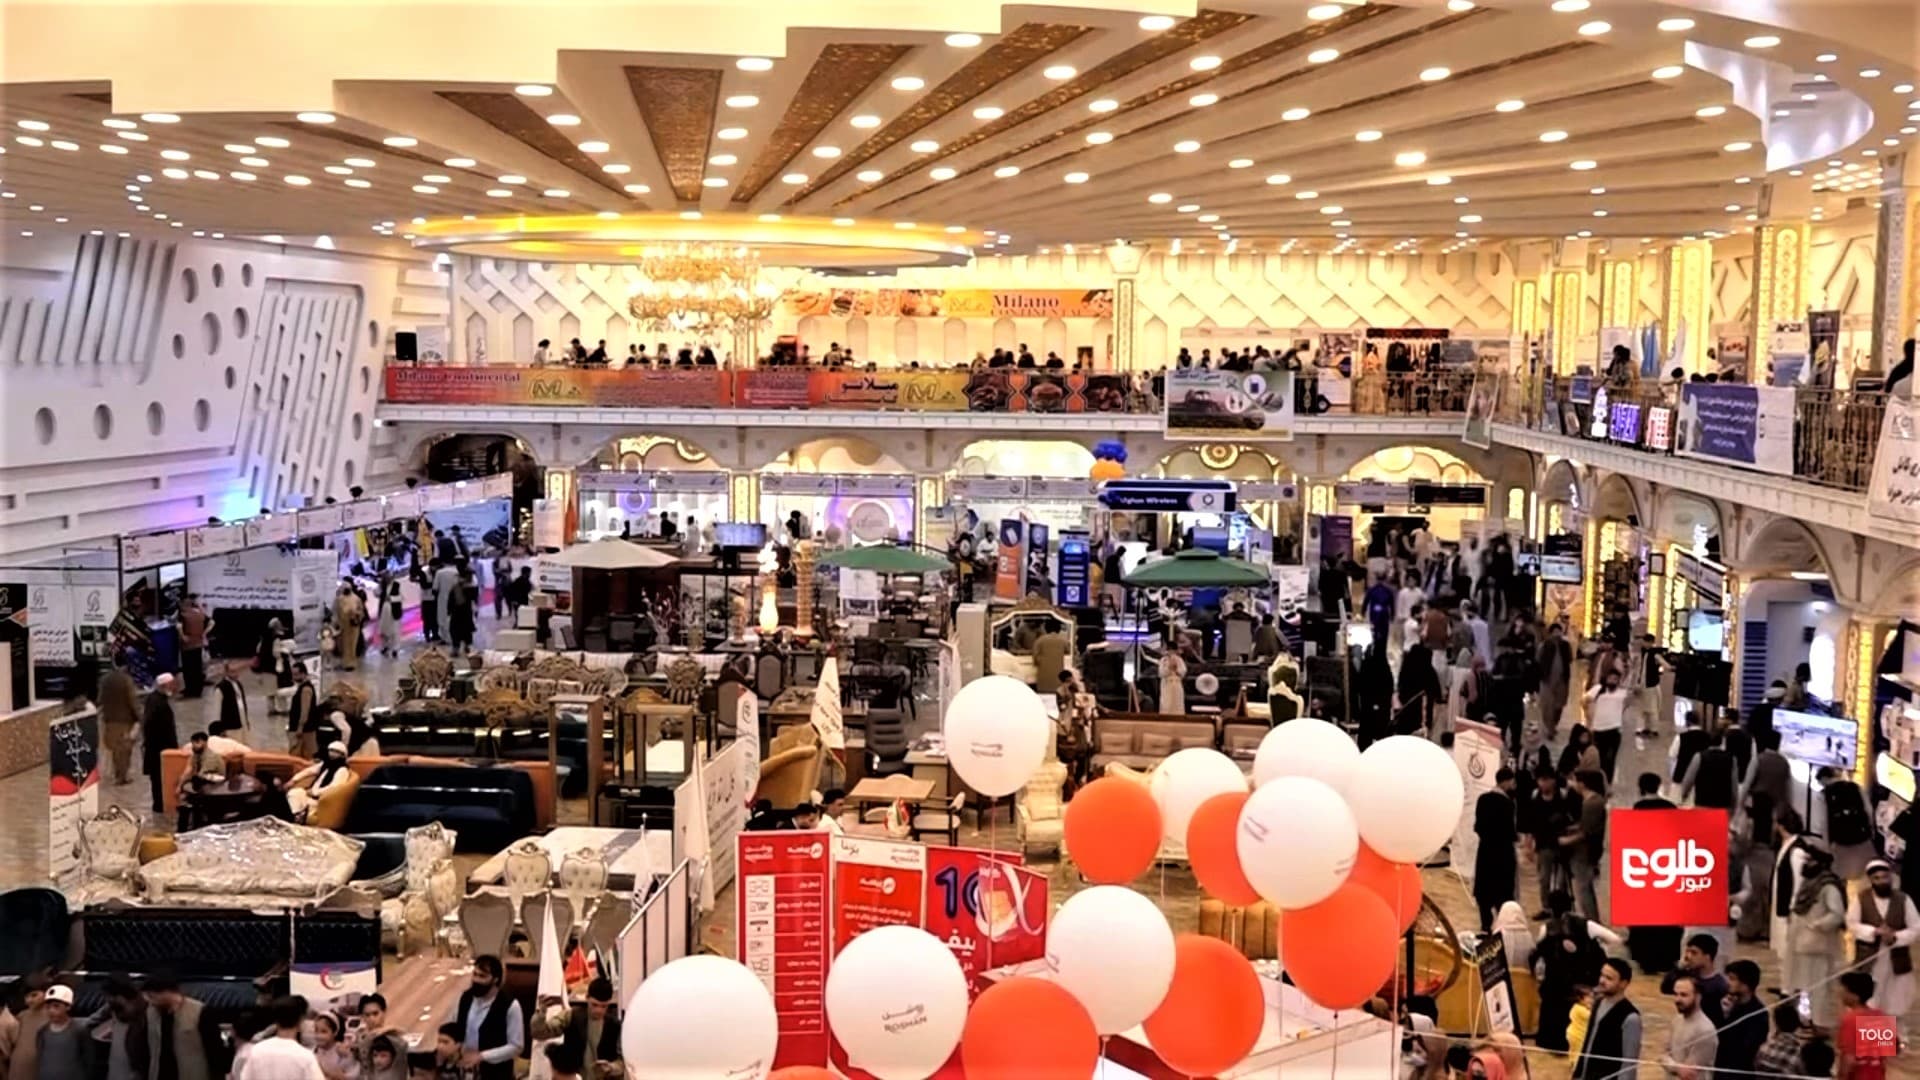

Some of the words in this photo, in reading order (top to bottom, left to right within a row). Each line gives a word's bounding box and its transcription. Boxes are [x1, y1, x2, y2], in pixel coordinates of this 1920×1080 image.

[993, 295, 1060, 308] Milano
[1146, 495, 1178, 505] Wireless
[883, 1015, 928, 1035] ROSHAN
